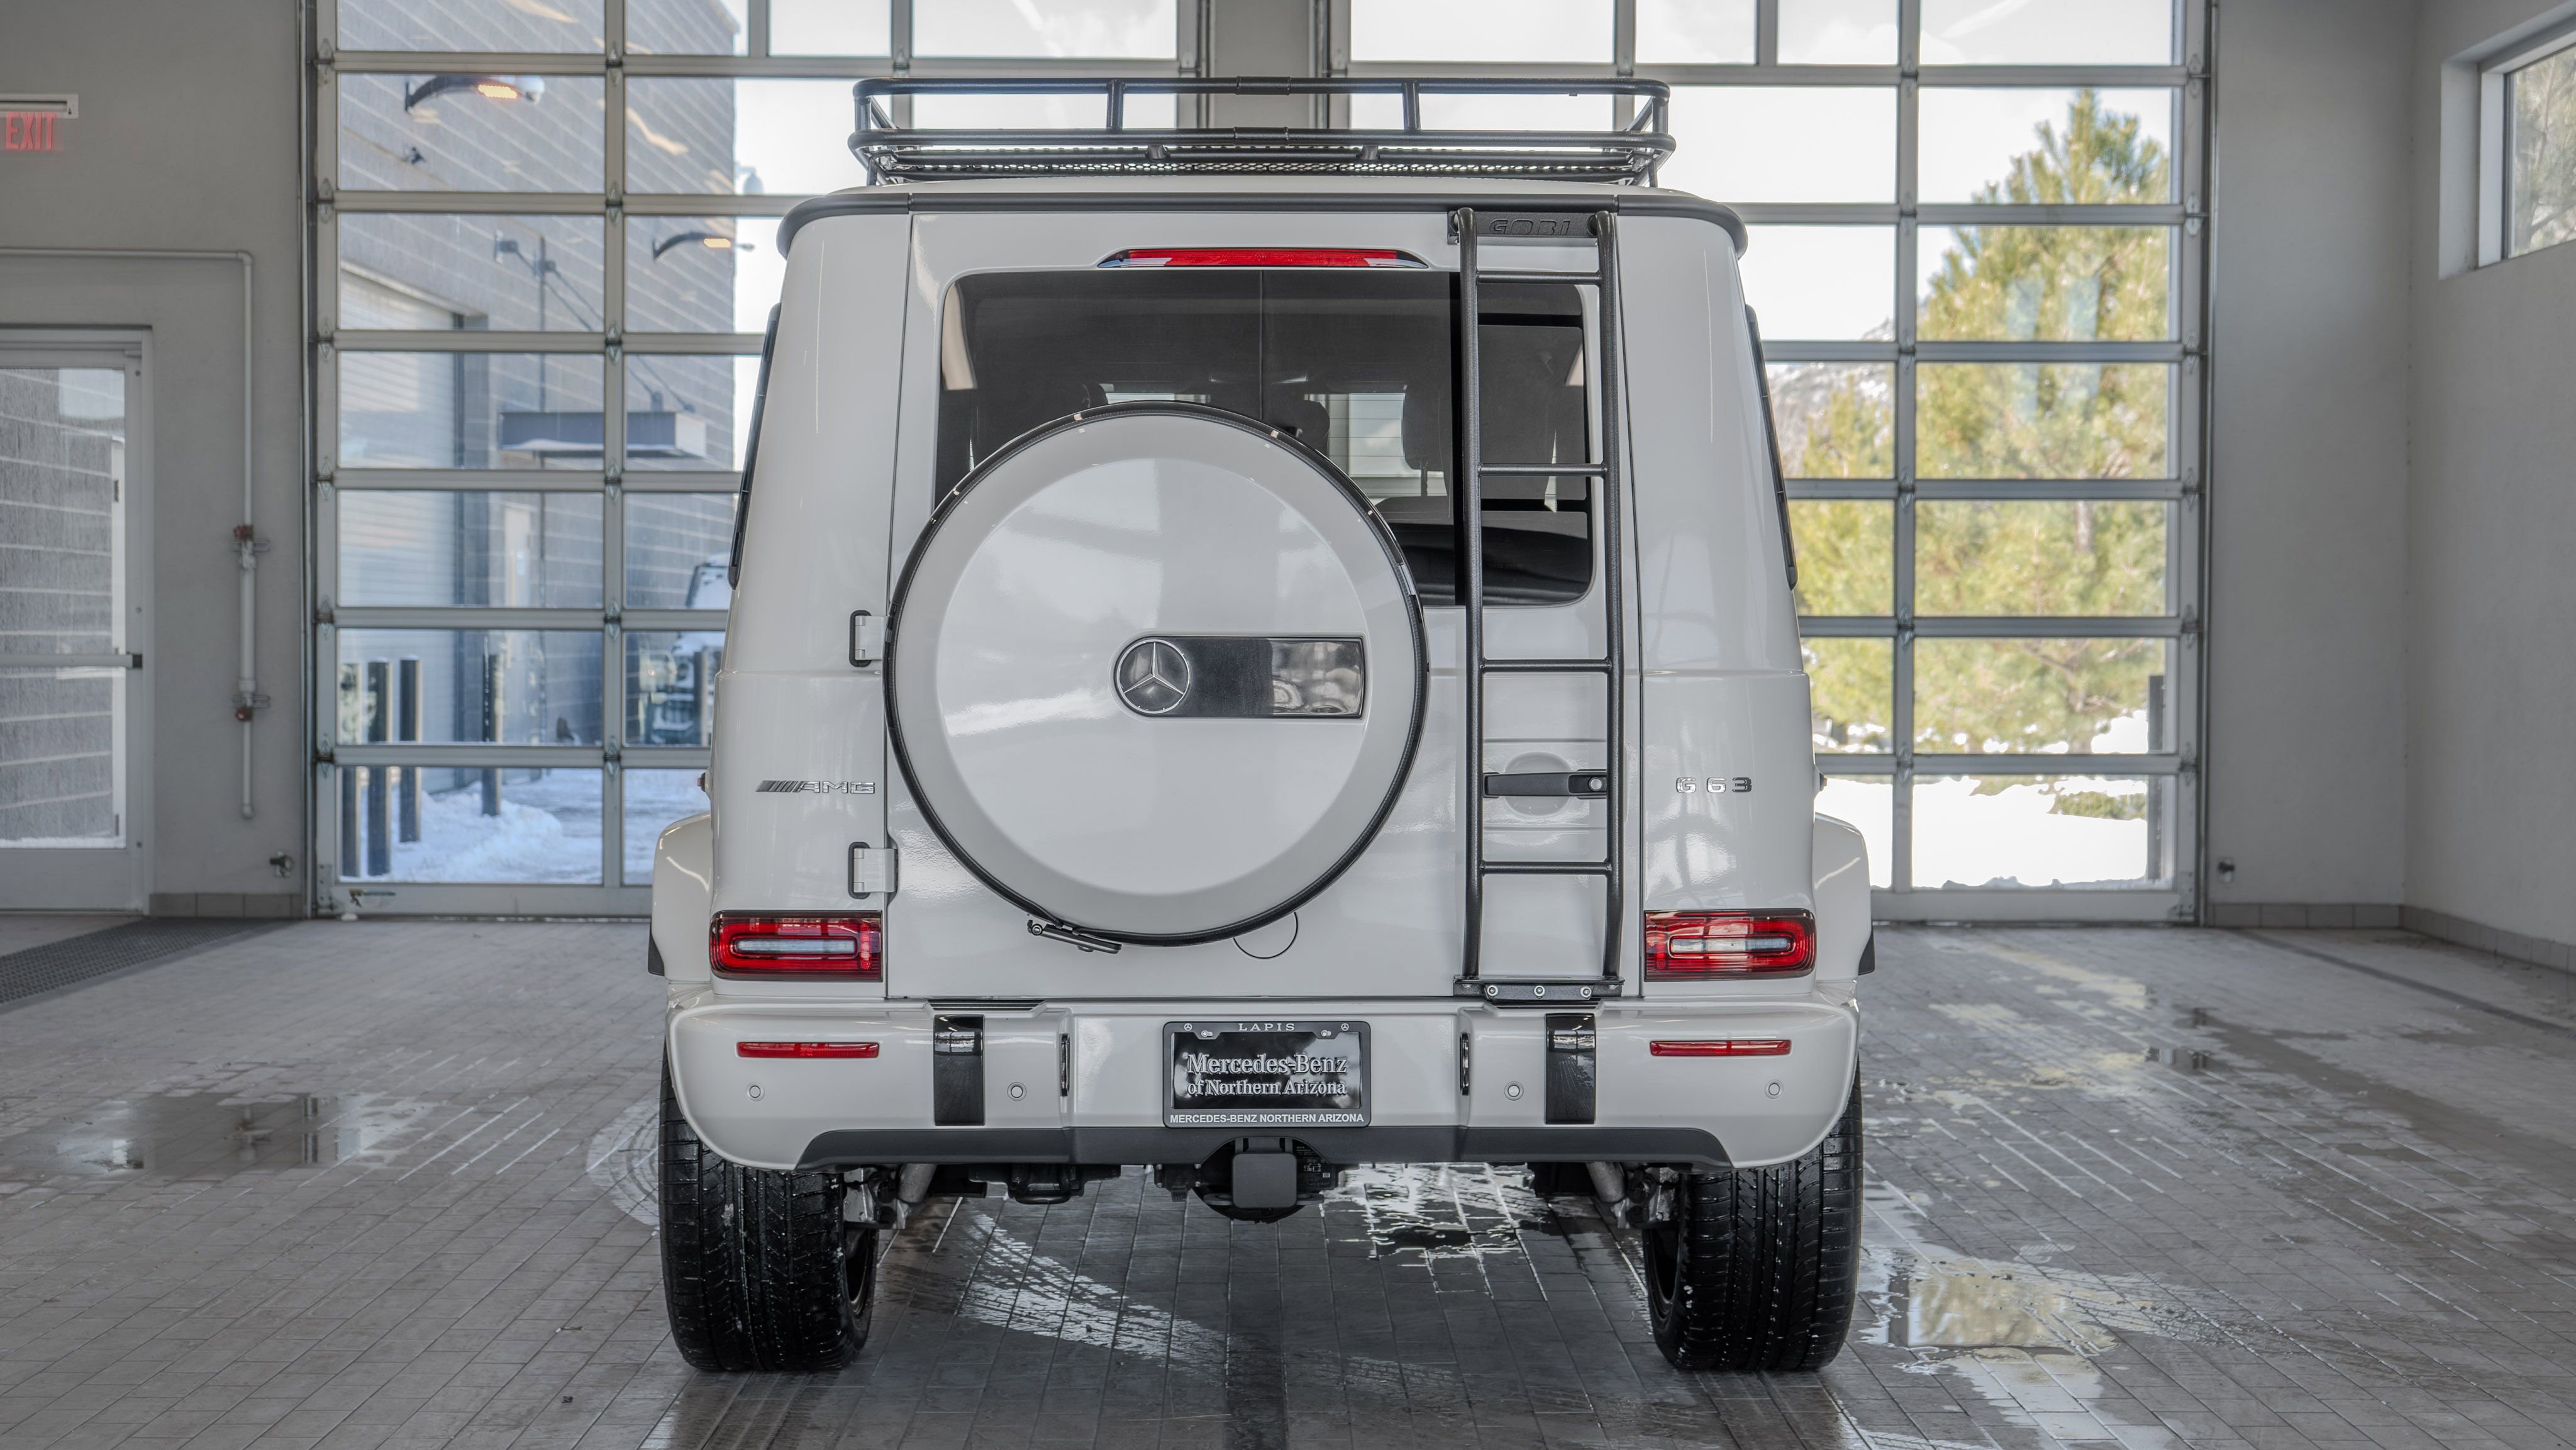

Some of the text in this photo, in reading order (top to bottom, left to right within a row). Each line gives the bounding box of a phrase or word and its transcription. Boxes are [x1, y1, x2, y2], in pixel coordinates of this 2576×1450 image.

[6, 111, 57, 150] EXIT
[1489, 218, 1570, 236] GOBI
[796, 780, 875, 794] AMG
[1238, 1023, 1295, 1031] LAPIS
[1187, 1054, 1348, 1074] Mercedes-Benz
[1187, 1078, 1346, 1096] of Northern Arizona
[1170, 1113, 1364, 1124] MERCEDES-BENZ NORTHERN ARIZONA
